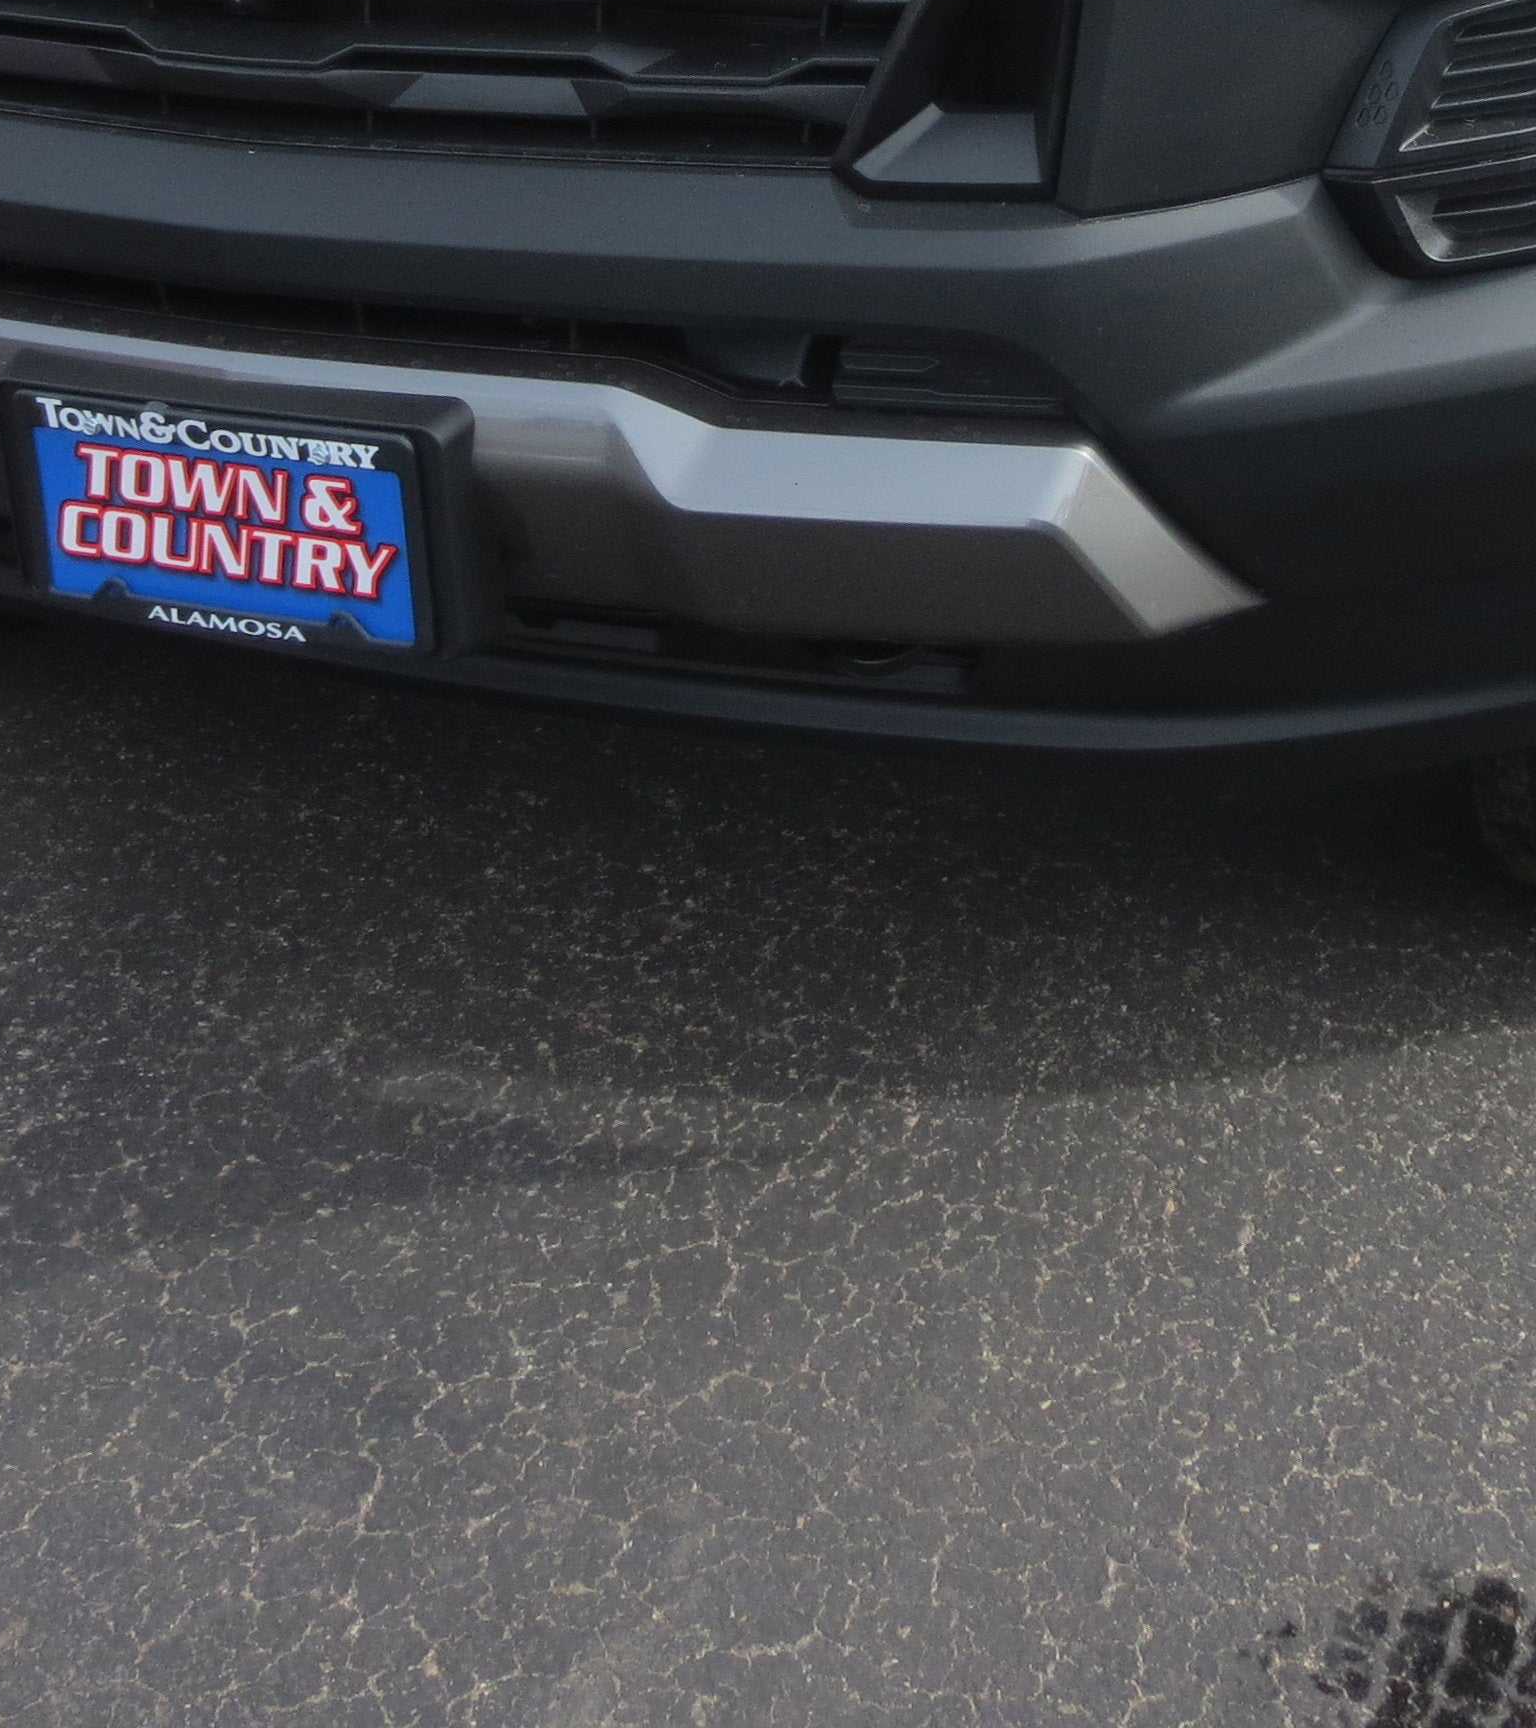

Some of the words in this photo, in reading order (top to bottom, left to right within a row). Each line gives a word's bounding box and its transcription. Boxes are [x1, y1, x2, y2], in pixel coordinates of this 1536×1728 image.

[75, 443, 289, 525] TOWN
[301, 474, 362, 536] &
[58, 500, 396, 600] COUNTRY
[148, 604, 306, 643] ALAMOSA
